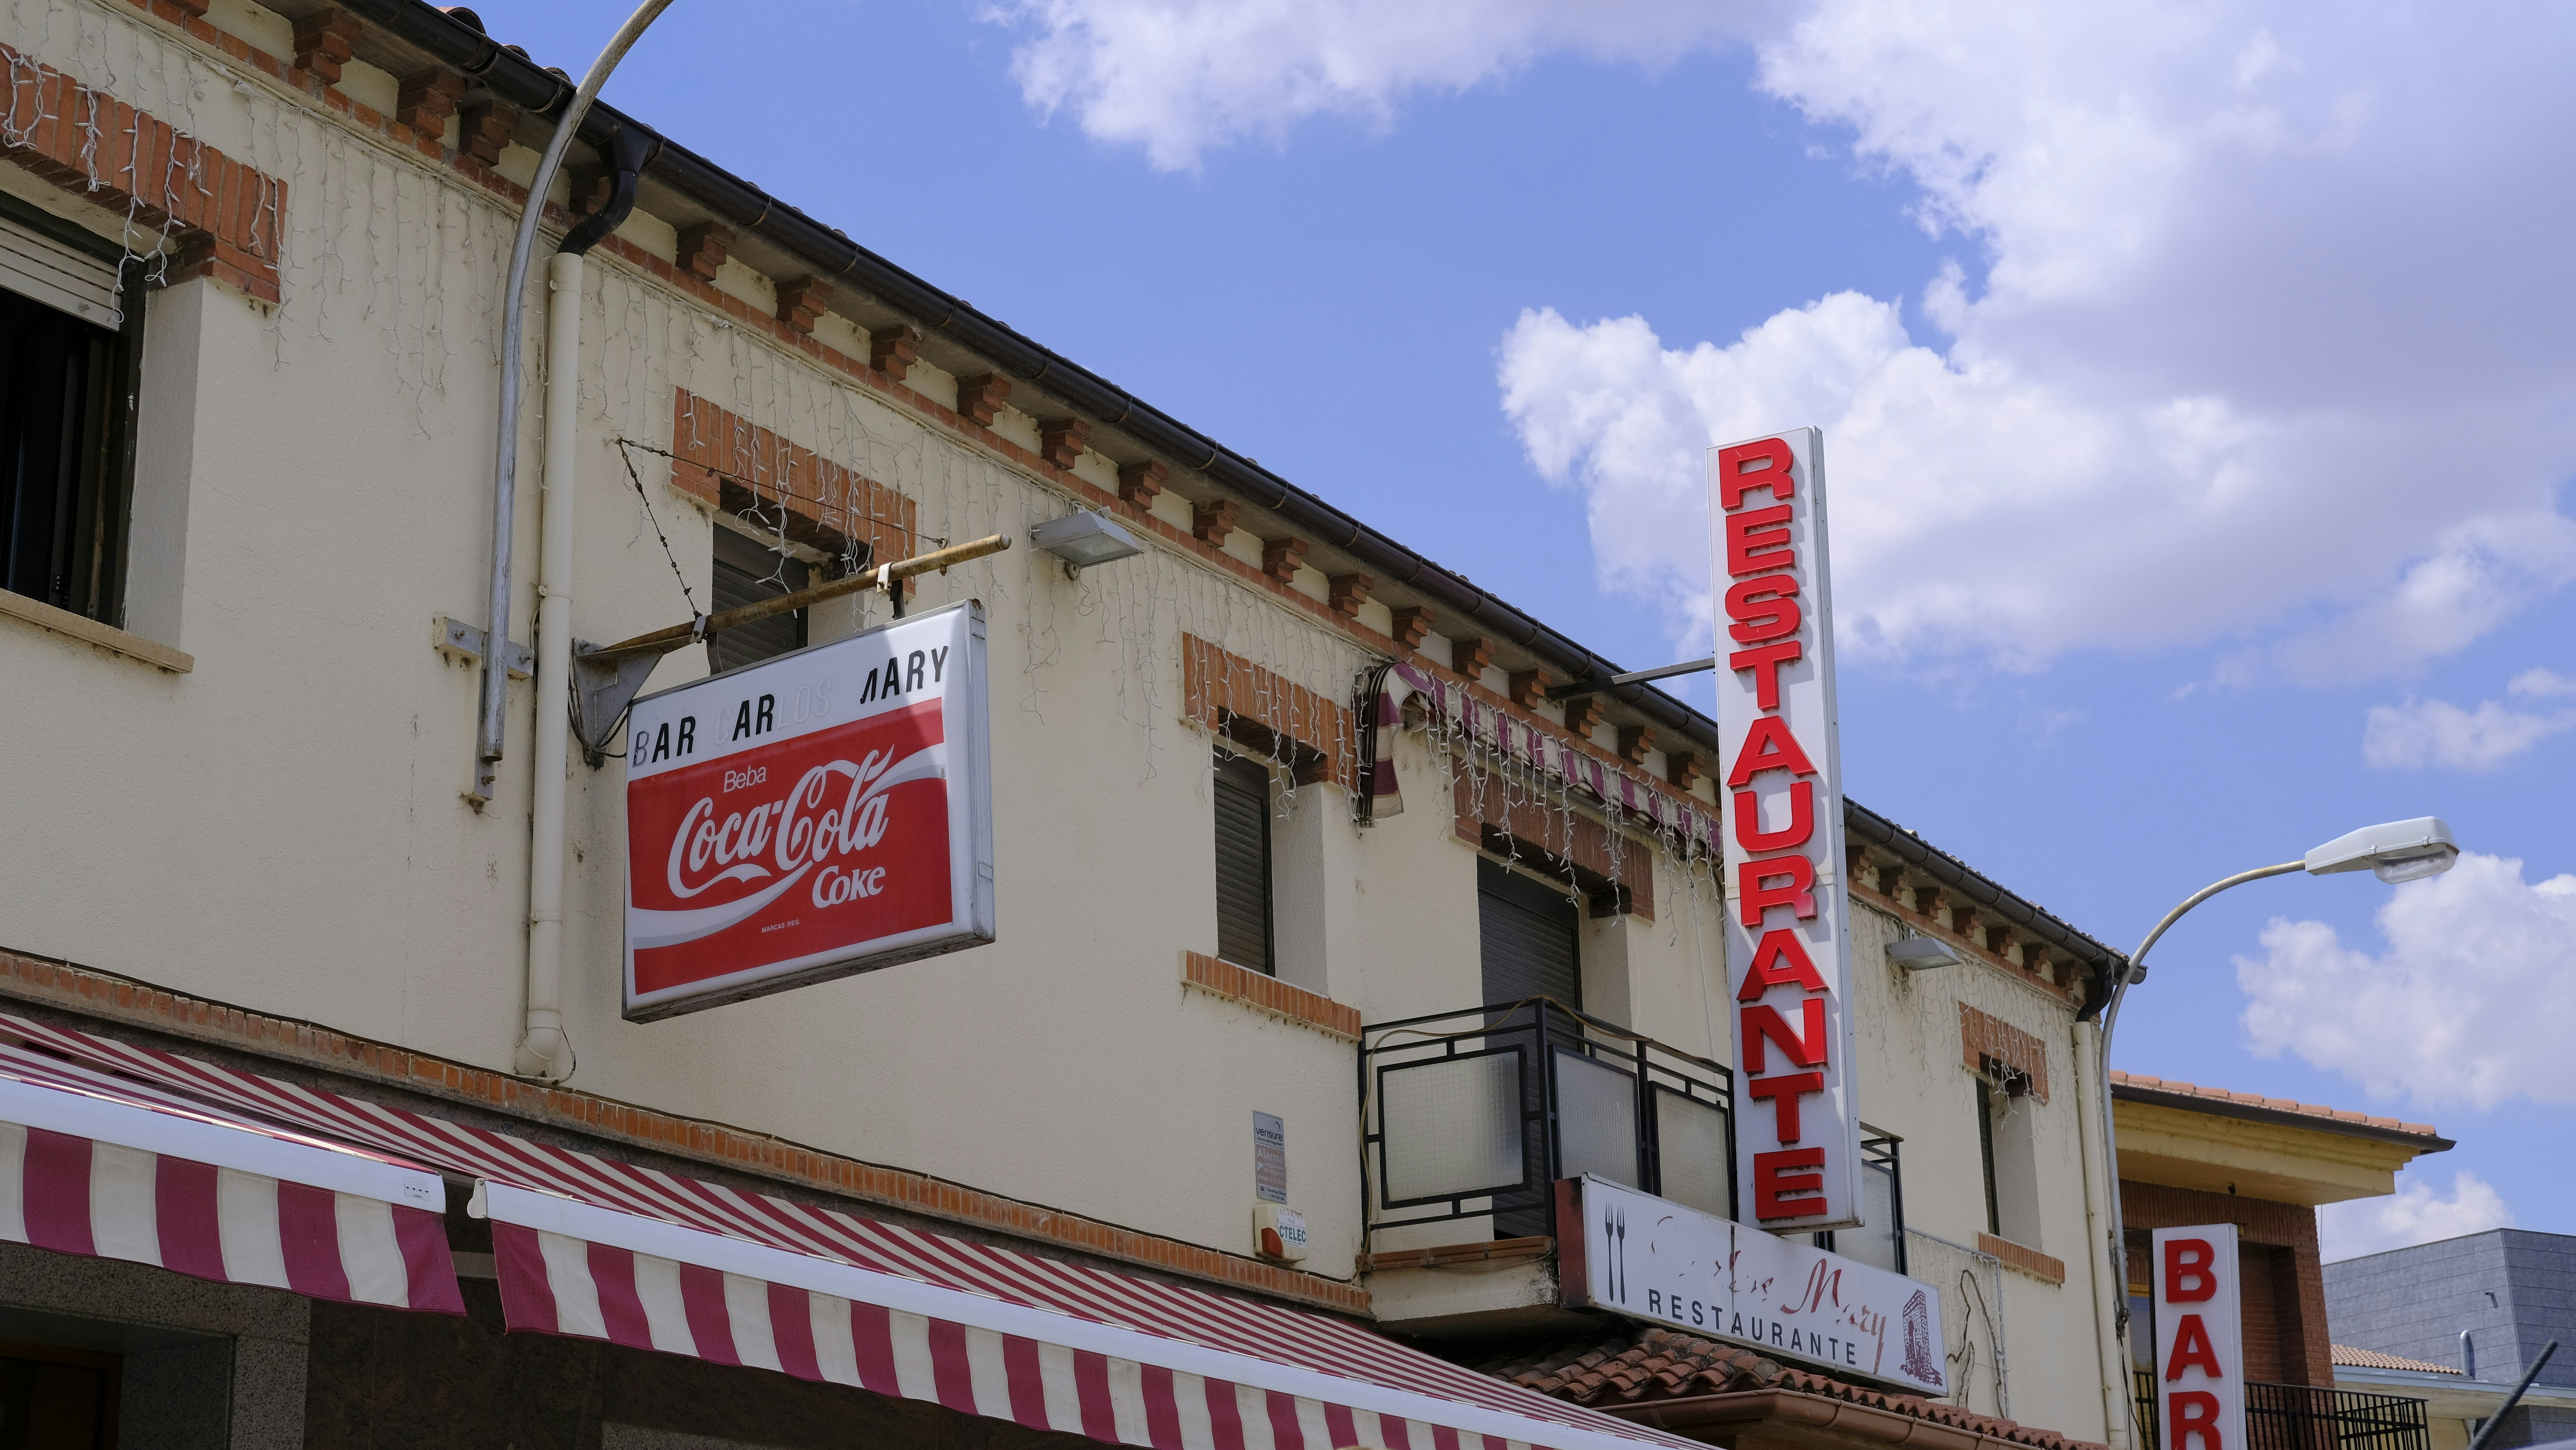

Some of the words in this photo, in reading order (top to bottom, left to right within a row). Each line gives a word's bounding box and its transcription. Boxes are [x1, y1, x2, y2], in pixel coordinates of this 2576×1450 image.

[632, 716, 696, 768] BAR
[723, 765, 767, 793] Beba
[667, 744, 895, 898] Coca-Cola
[1718, 437, 1828, 1220] RESTAURANTE
[812, 865, 886, 909] Coke
[762, 923, 785, 933] MARCAS
[1256, 1128, 1282, 1141] verisure
[1257, 1147, 1284, 1163] Alarma
[1279, 1208, 1303, 1220] ALARMA
[1279, 1225, 1306, 1243] CTELEC
[1648, 1288, 1856, 1365] RESTAURANTE
[1780, 1258, 1886, 1375] Mry
[2164, 1238, 2223, 1450] BAR
